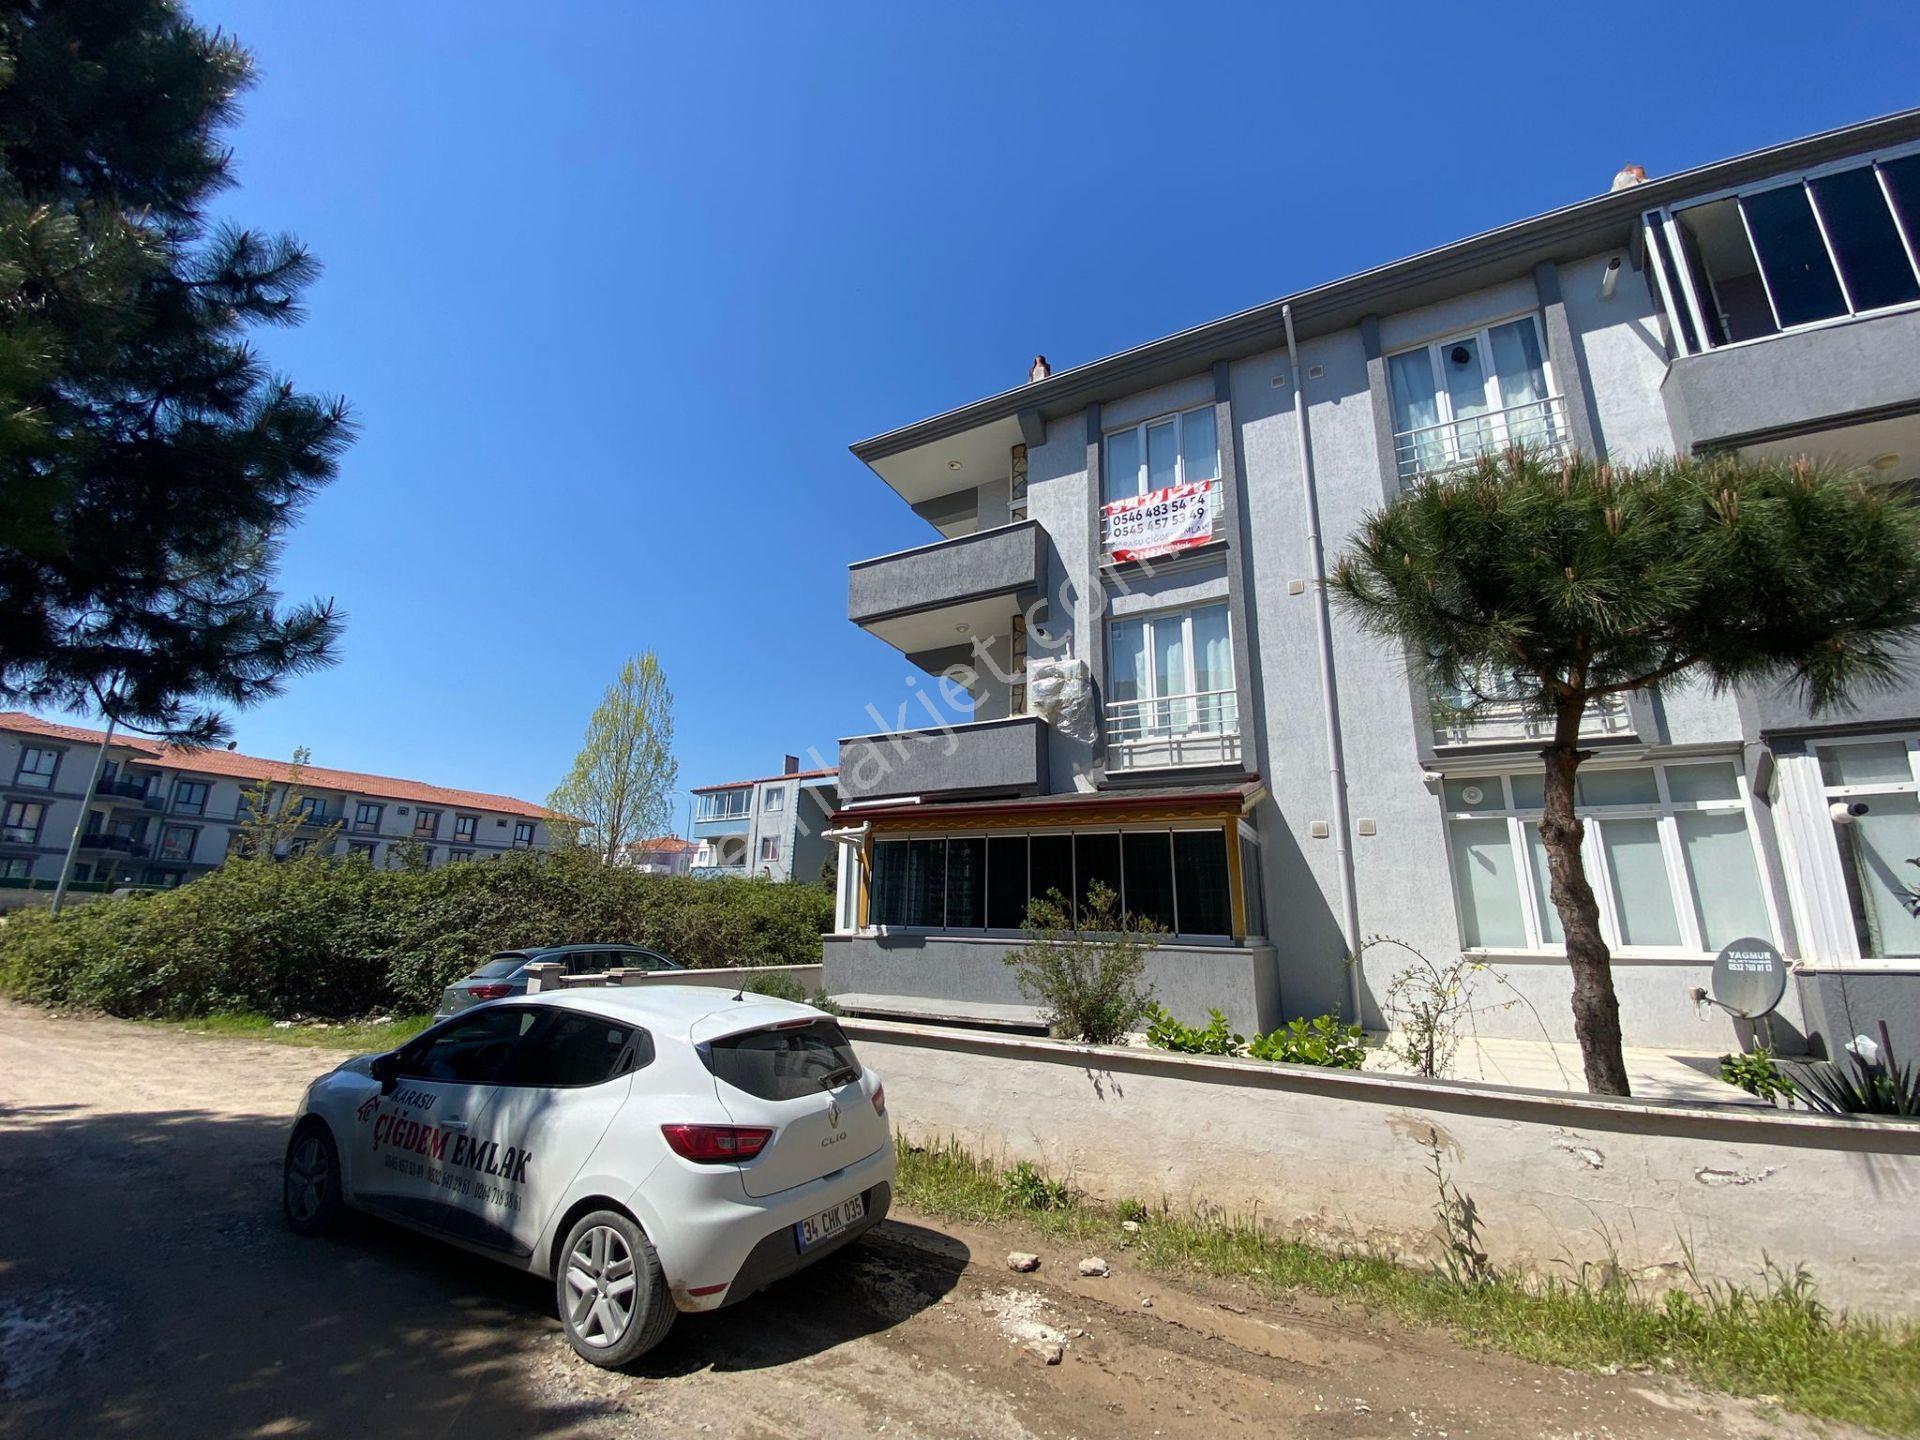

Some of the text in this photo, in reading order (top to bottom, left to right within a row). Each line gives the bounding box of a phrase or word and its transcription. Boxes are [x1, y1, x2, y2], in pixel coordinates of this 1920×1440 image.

[1113, 510, 1143, 526] 0546
[1146, 504, 1168, 518] 483
[1172, 500, 1187, 512] 54
[1113, 507, 1204, 538] 0545 457 53 49
[391, 1088, 437, 1110] KARASU
[373, 1109, 532, 1184] ÇİĞDEM EMLAK
[821, 1131, 847, 1148] CLIO
[803, 1219, 818, 1243] 34
[821, 1208, 842, 1232] CHK
[844, 1197, 862, 1222] 035
